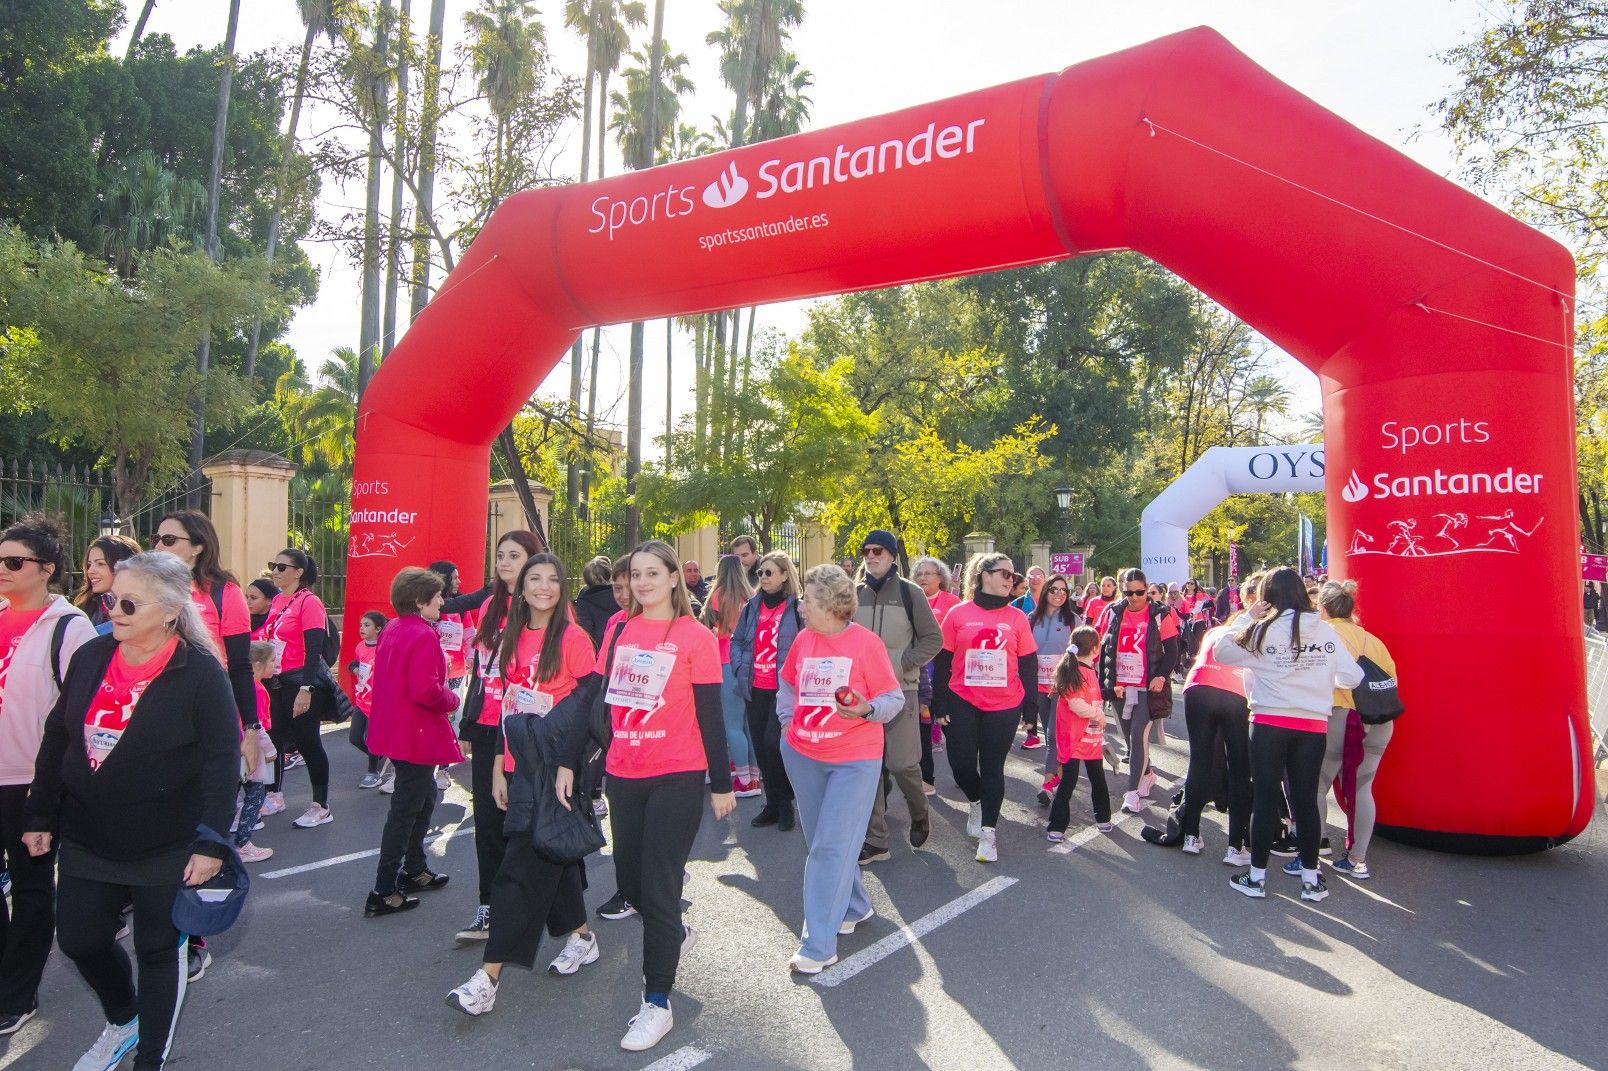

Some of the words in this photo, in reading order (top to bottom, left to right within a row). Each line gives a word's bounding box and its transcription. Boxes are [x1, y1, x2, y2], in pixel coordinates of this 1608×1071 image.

[588, 183, 696, 241] Sports
[755, 118, 986, 199] Santander
[698, 211, 830, 252] sportssantander.es
[1380, 416, 1490, 454] Sports
[1373, 466, 1544, 499] Santander
[1054, 555, 1069, 563] SUB
[1142, 555, 1177, 565] OYSHO
[629, 673, 650, 685] 016
[814, 677, 832, 686] 016
